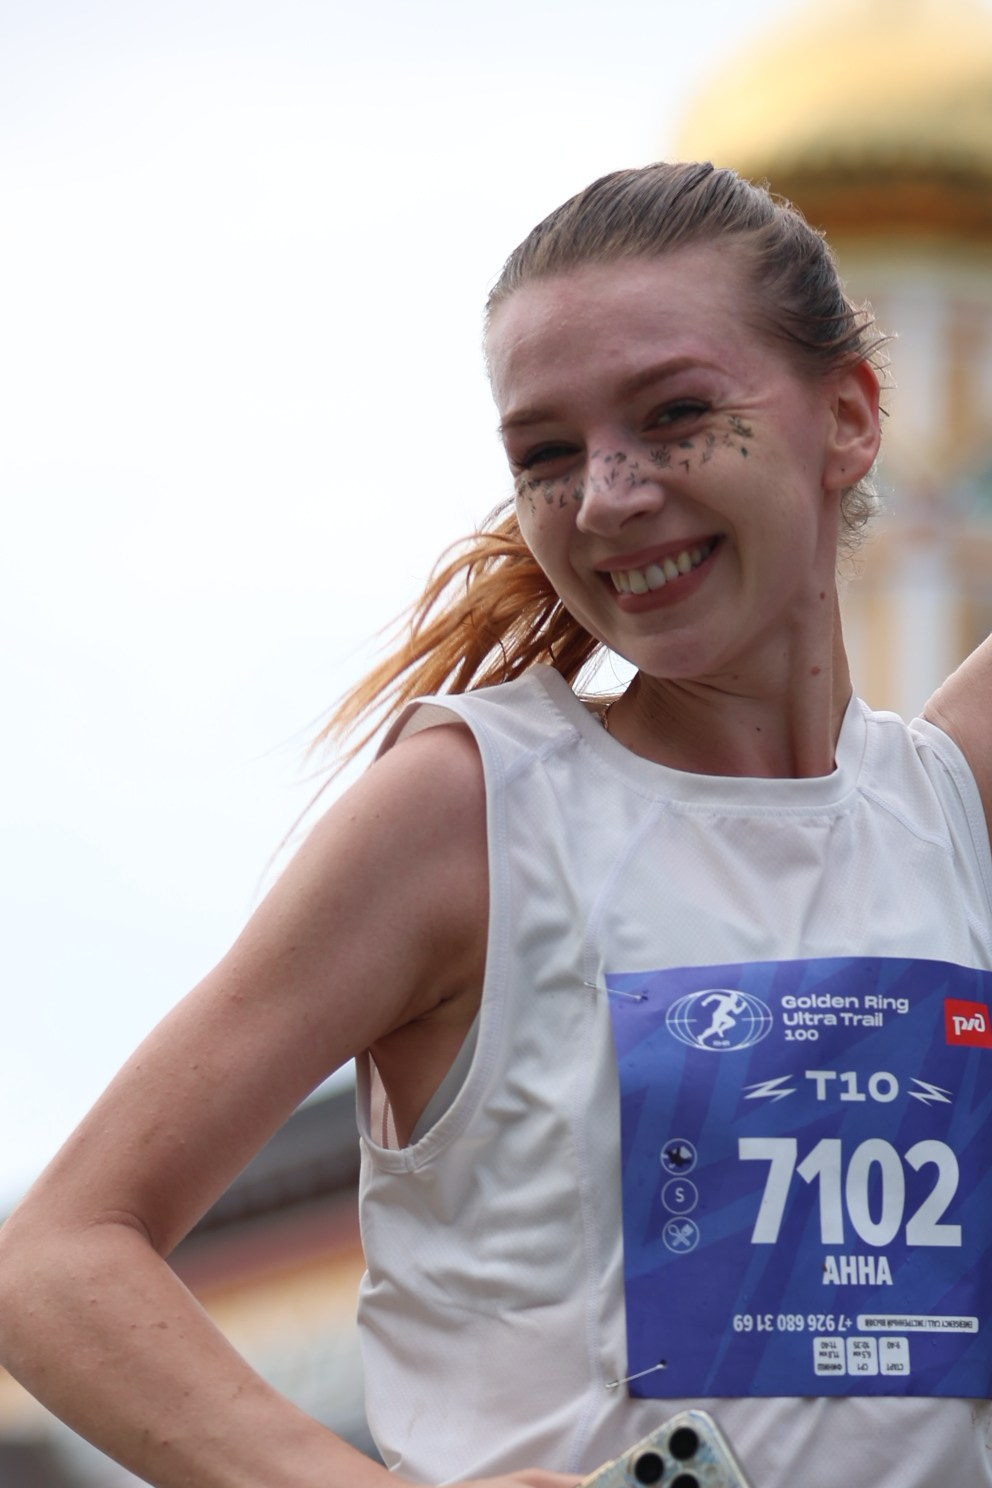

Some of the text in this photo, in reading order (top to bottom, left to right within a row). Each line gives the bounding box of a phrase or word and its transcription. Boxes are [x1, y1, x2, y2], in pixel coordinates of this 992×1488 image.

[781, 993, 909, 1014] Golden Ring
[783, 1011, 883, 1027] Ultra Trail
[785, 1029, 819, 1041] 100
[805, 1070, 899, 1103] T10
[675, 1187, 685, 1203] S
[738, 1137, 962, 1247] 7102
[822, 1256, 893, 1286] АННА
[733, 1314, 853, 1332] +7 926 680 31 69
[927, 1319, 941, 1328] CALL
